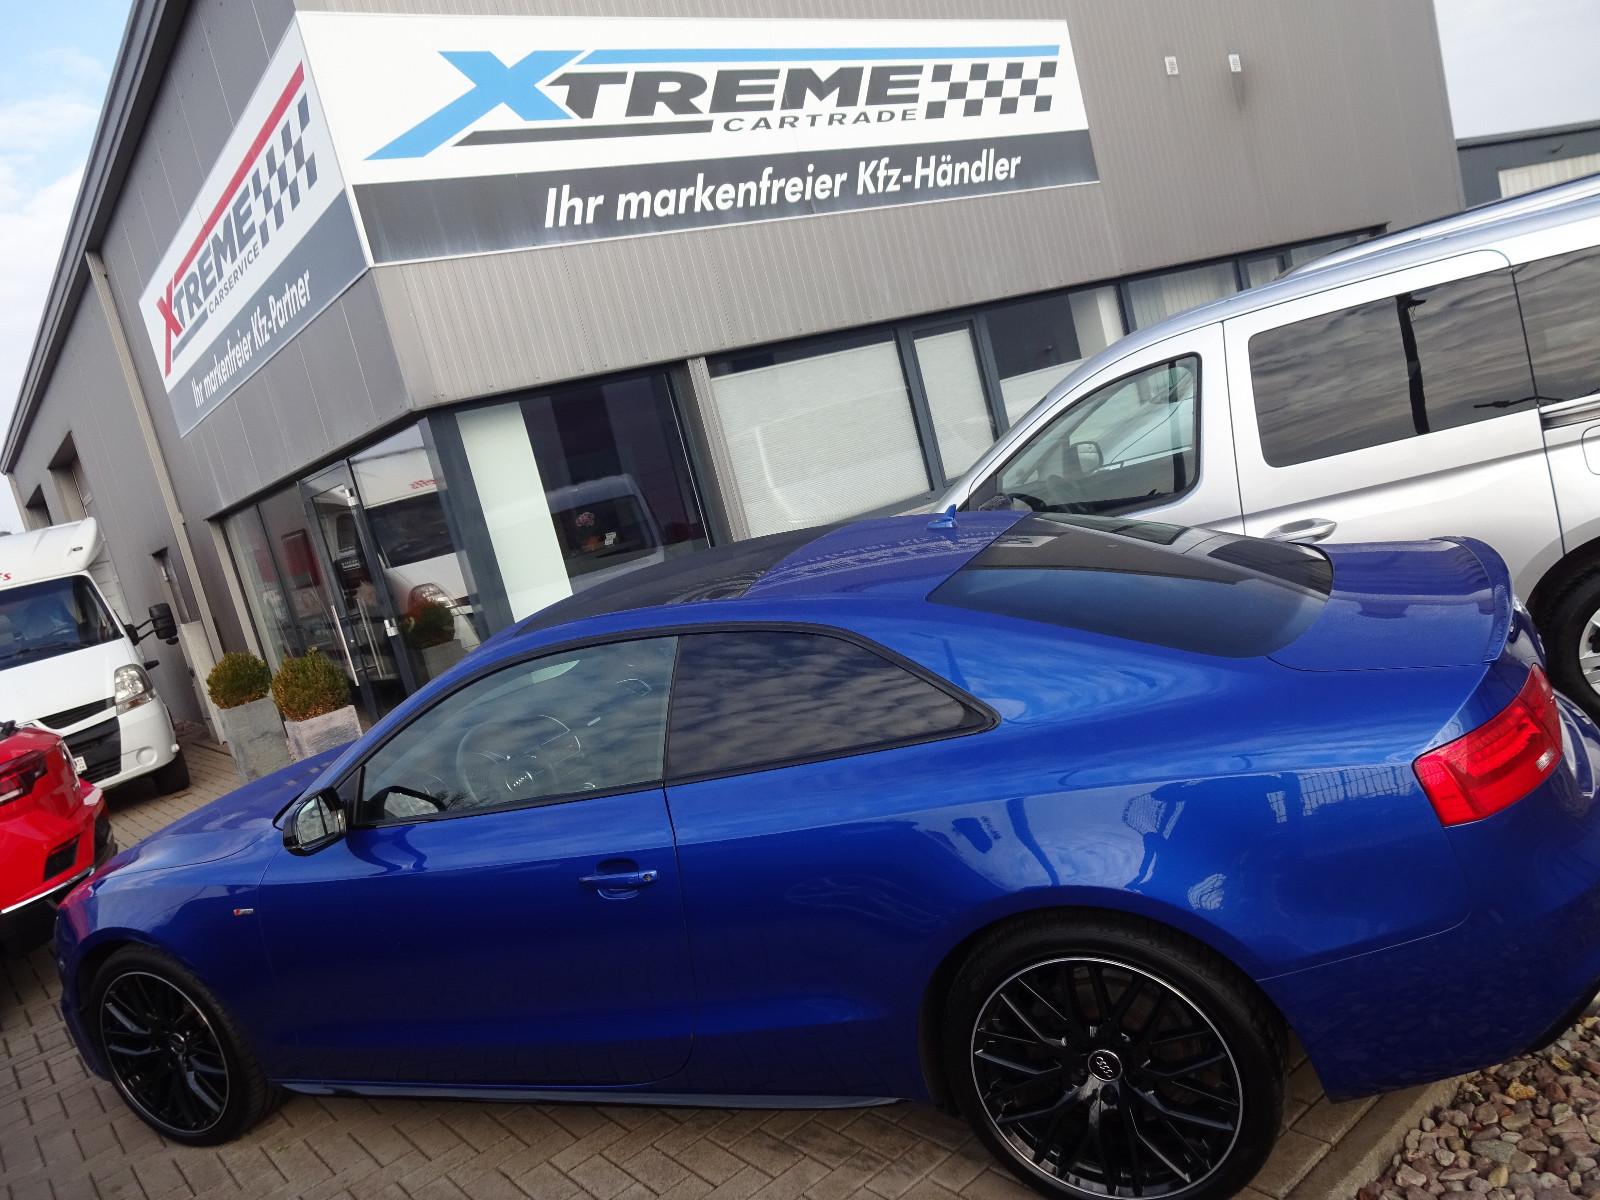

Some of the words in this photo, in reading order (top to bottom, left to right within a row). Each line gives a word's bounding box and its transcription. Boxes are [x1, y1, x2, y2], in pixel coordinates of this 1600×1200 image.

[363, 50, 925, 160] XTREME
[723, 107, 919, 133] CARTRADE
[544, 184, 605, 229] Ihr
[616, 163, 848, 222] markenfreier
[856, 148, 1022, 195] Kfz-Händler
[156, 183, 257, 379] XTREME
[208, 240, 260, 314] CARSERVICE
[191, 377, 204, 409] Ihr
[202, 328, 253, 399] markenfreier
[250, 269, 311, 351] Kfz-Partner
